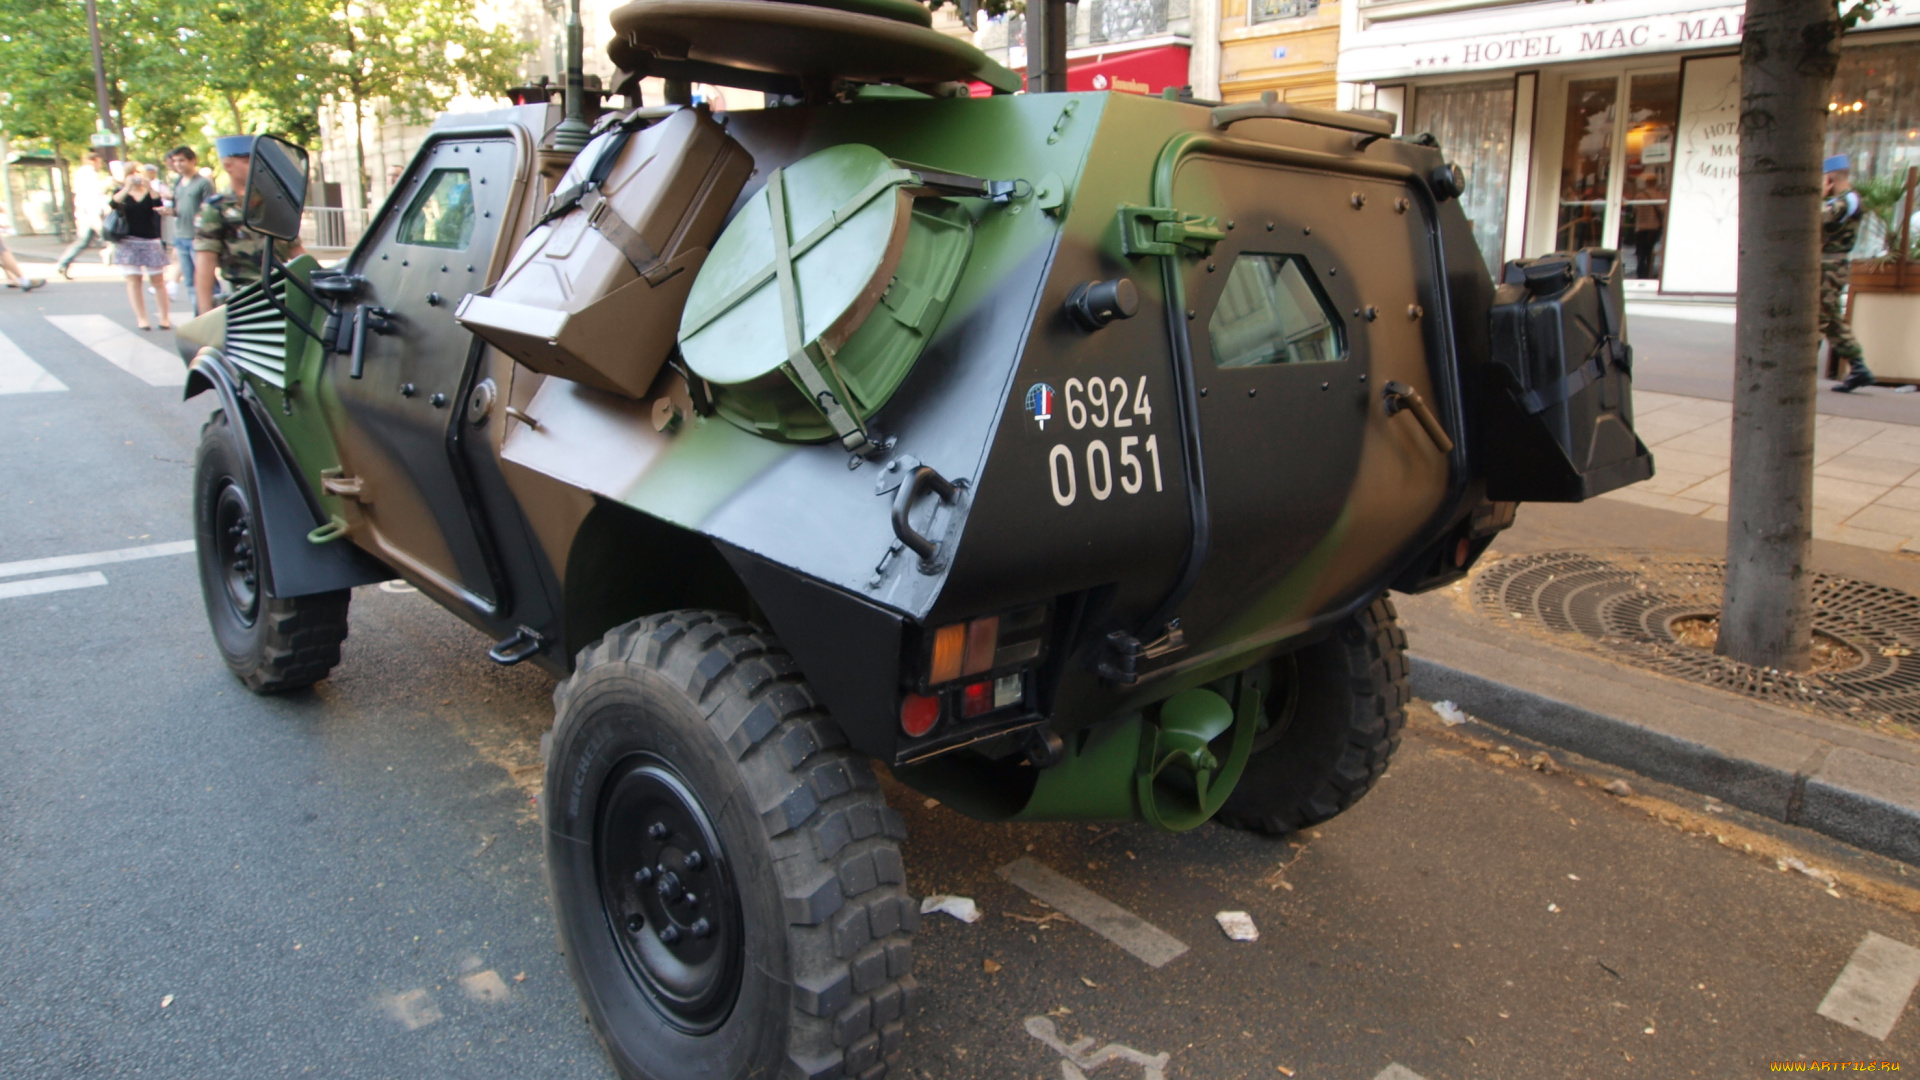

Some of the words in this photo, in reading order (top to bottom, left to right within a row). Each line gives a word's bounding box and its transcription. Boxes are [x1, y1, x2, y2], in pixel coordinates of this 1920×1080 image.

[1463, 35, 1561, 63] HOTEL
[1579, 25, 1648, 51] MAC
[1704, 122, 1739, 140] HOT
[1065, 375, 1151, 430] 6924
[1049, 434, 1162, 506] 0051
